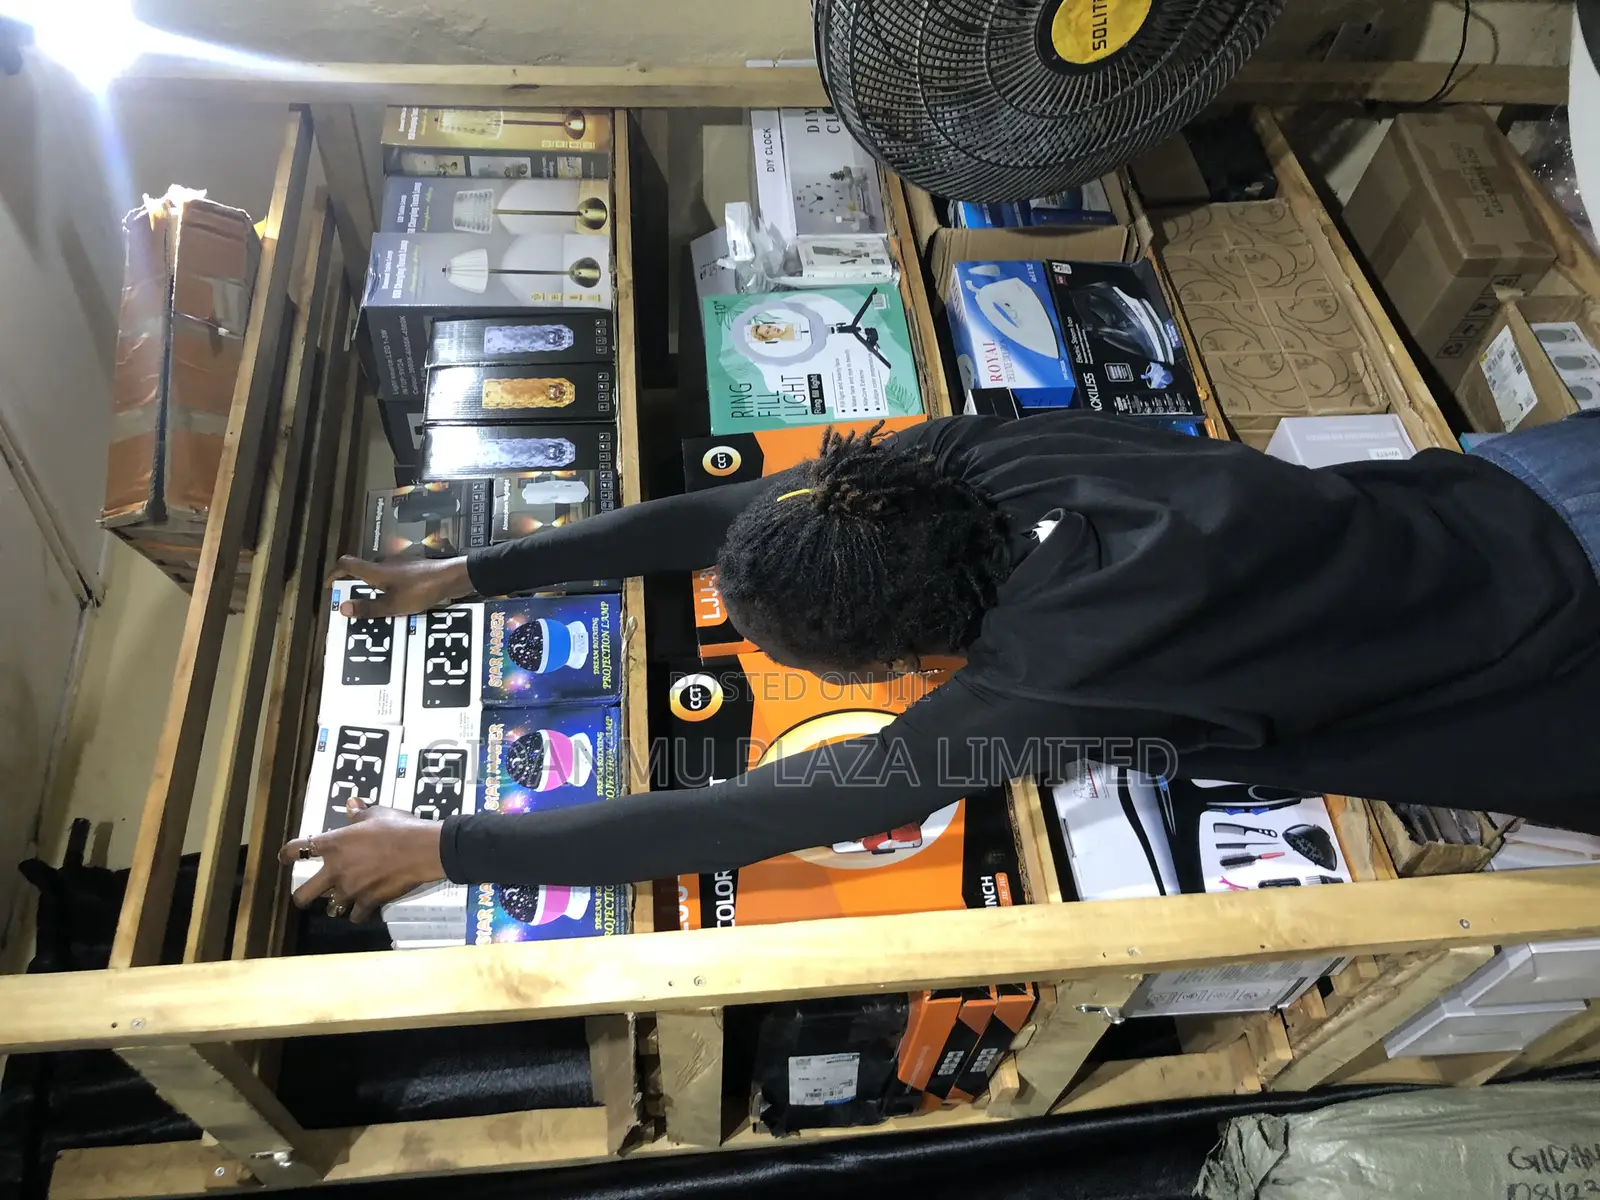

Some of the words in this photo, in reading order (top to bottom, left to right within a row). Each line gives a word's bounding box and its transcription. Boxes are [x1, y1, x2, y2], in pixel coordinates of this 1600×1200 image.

[1092, 0, 1108, 51] SOLIT
[804, 108, 820, 133] DIY
[763, 128, 773, 155] CLOCK
[765, 159, 776, 172] DIY
[408, 207, 420, 227] Charging
[396, 254, 407, 268] Touch
[394, 268, 406, 289] Charging
[1066, 316, 1075, 327] Iron
[1069, 328, 1079, 344] Steam
[982, 340, 1003, 382] ROYAL
[1073, 345, 1083, 363] Electric
[780, 375, 808, 416] LIGHT
[810, 375, 820, 389] light
[728, 382, 754, 419] RING
[755, 390, 781, 417] FILL
[813, 399, 822, 414] Ring
[716, 452, 727, 469] CCT
[503, 478, 511, 501] Nightlight
[375, 497, 385, 520] Nightlight
[502, 502, 510, 531] Atmosphere
[372, 521, 382, 552] Atmosphere
[699, 565, 721, 620] LJJ-3
[600, 601, 610, 629] LAMP
[489, 611, 506, 656] MASTER
[592, 617, 600, 649] ROTATING
[426, 611, 469, 686] 12:34
[601, 629, 612, 689] PROJECTION
[488, 657, 504, 687] STAR
[689, 686, 702, 710] CCT
[605, 715, 613, 746] LAMP
[486, 724, 505, 774] MASTER
[413, 752, 463, 821] 2:34
[605, 748, 616, 799] OJECTION
[483, 776, 502, 811] STAR
[604, 885, 616, 936] ROJECTIO
